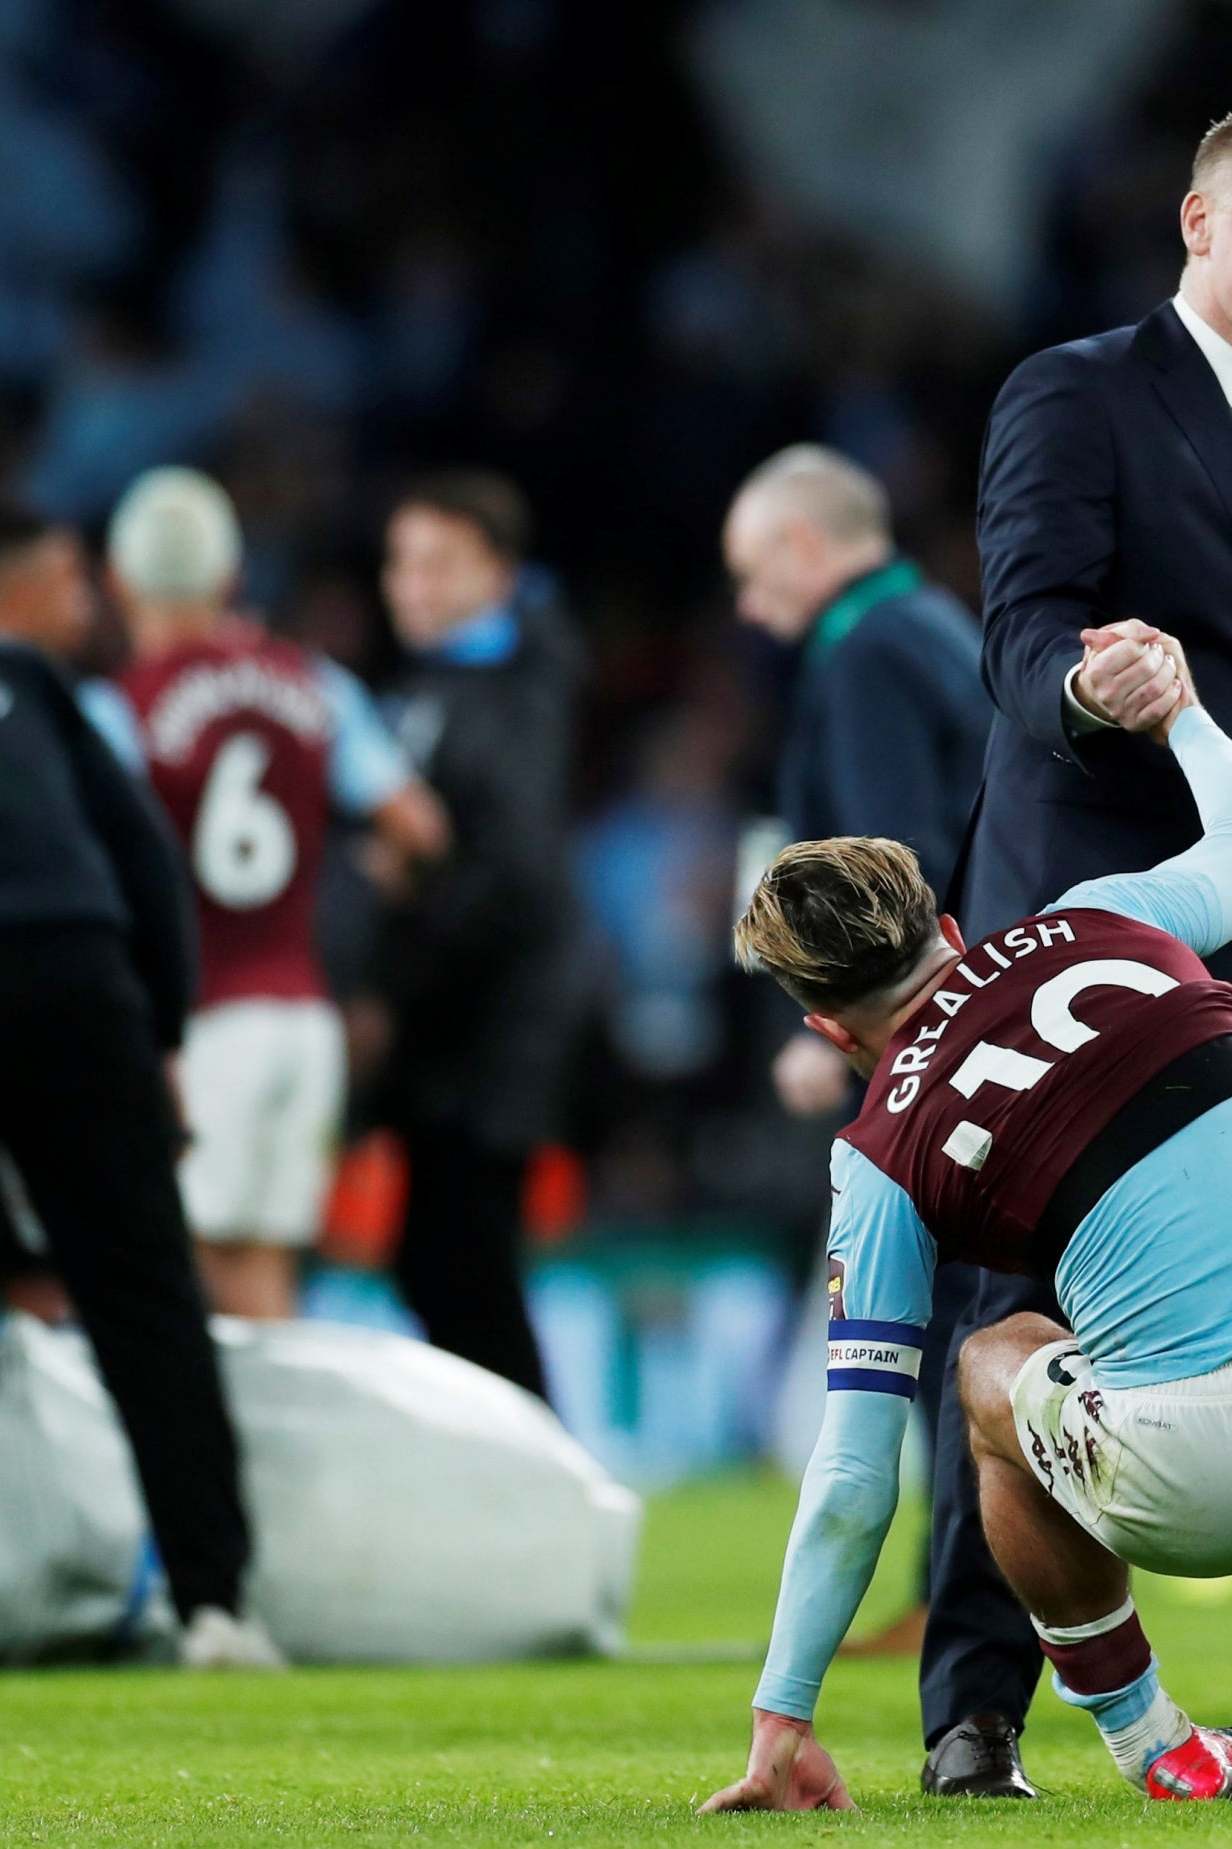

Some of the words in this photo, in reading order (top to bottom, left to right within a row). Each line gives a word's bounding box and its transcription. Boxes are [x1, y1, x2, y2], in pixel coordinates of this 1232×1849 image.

[194, 732, 297, 909] 6
[886, 919, 1076, 1114] GREALISH
[845, 1348, 899, 1364] CAPTAIN
